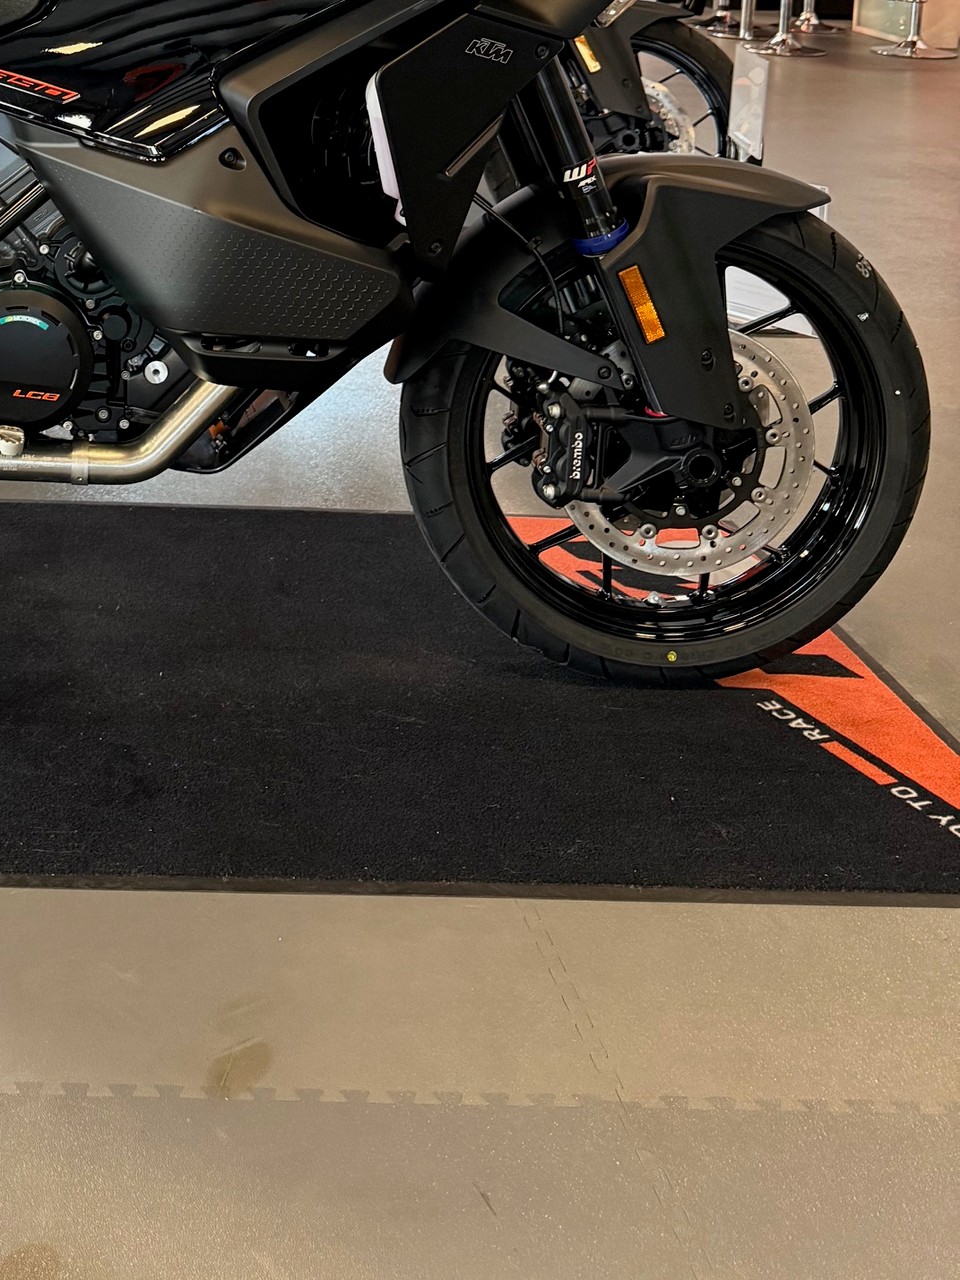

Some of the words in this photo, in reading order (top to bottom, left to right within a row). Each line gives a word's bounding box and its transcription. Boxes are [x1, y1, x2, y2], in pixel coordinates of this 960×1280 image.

[465, 37, 514, 64] KTM
[12, 389, 60, 402] LC8
[569, 431, 584, 480] brembo
[756, 700, 831, 741] RACE
[890, 785, 933, 811] TO
